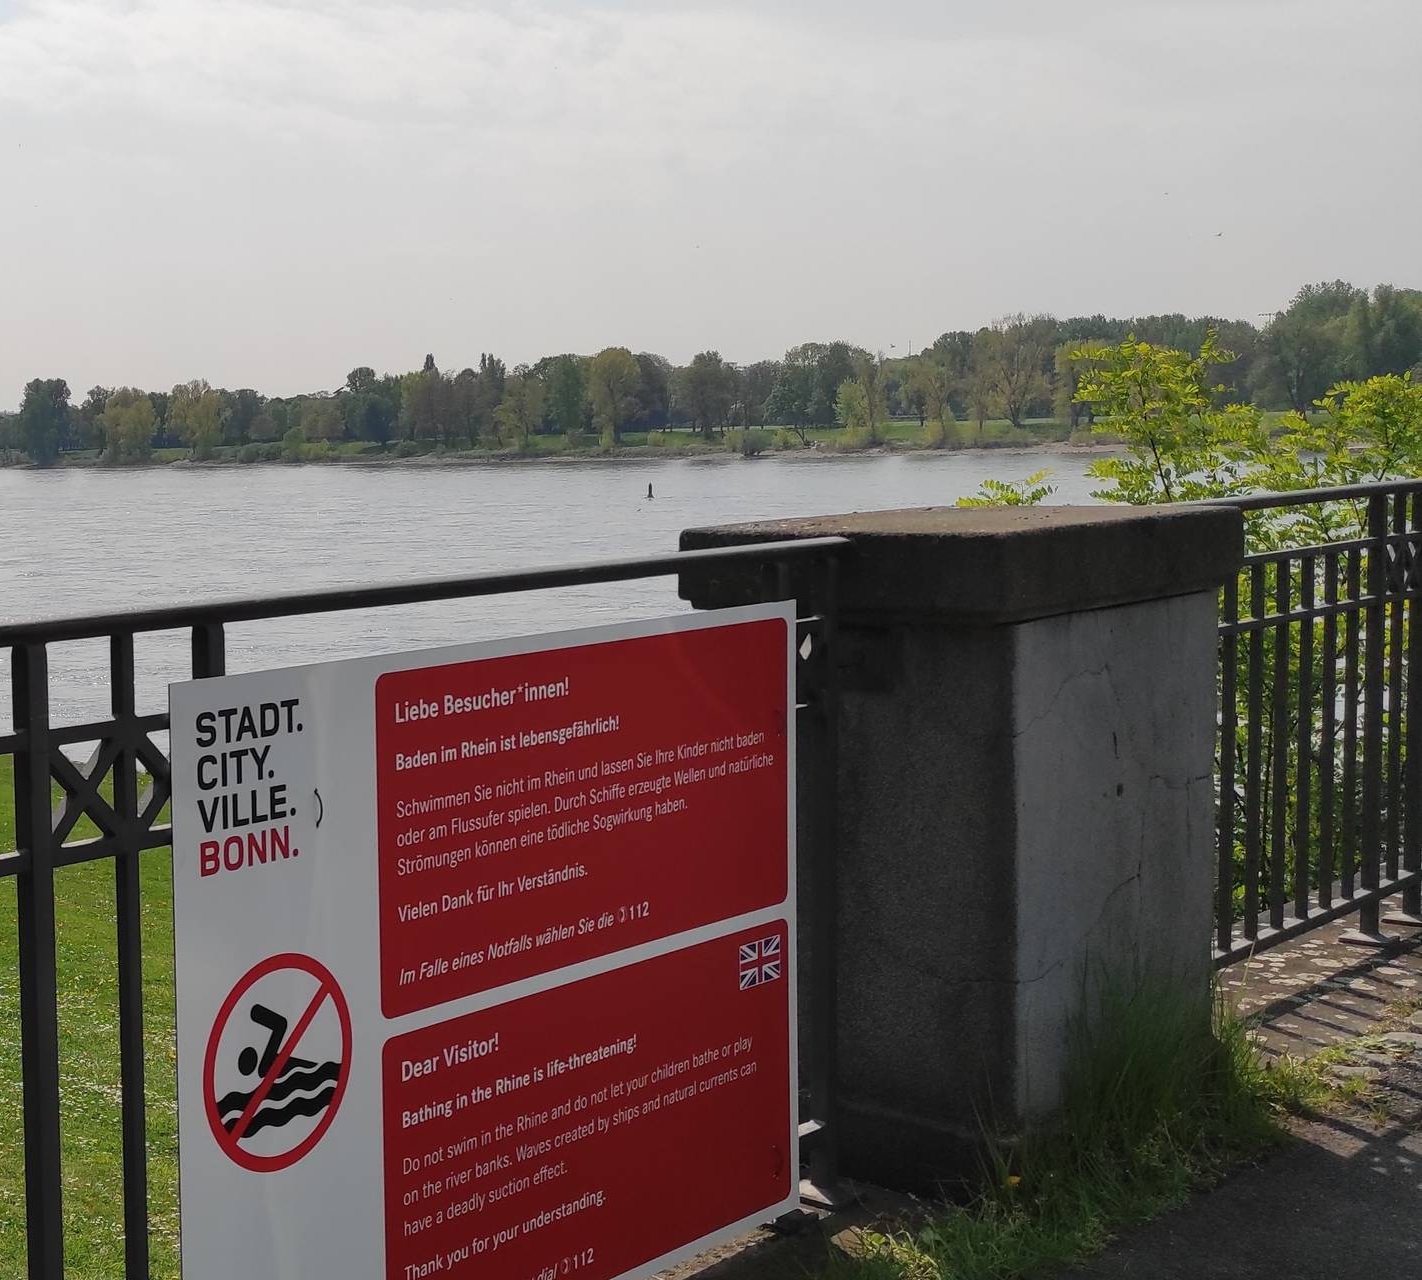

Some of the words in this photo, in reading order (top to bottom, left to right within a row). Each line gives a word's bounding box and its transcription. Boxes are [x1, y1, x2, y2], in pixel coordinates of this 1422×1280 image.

[195, 698, 303, 748] STADT.
[395, 698, 439, 724] Liebe
[395, 749, 437, 771] Baden
[440, 745, 458, 763] im
[461, 737, 497, 759] Rhein
[500, 734, 517, 752] ist
[519, 714, 620, 748] lebensgefährlich!
[197, 745, 275, 791] CITY.
[396, 791, 471, 818] Schwimmen
[474, 784, 493, 802] Sie
[495, 777, 525, 798] nicht
[527, 774, 542, 792] im
[544, 767, 575, 788] Rhein
[578, 761, 598, 781] und
[601, 758, 634, 776] lassen
[636, 752, 653, 769] Sie
[655, 749, 675, 765] Ihre
[677, 741, 709, 761] Kinder
[710, 735, 734, 753] nicht
[736, 731, 765, 748] baden
[396, 827, 426, 847] oder
[428, 824, 448, 841] am
[451, 809, 505, 835] Flussufer
[507, 801, 551, 827] spielen.
[554, 791, 587, 813] Durch
[589, 782, 626, 805] Schiffe
[628, 775, 672, 797] erzeugte
[673, 767, 706, 787] Wellen
[708, 760, 726, 779] und
[728, 753, 774, 774] natürliche
[197, 784, 296, 833] VILLE.
[397, 847, 472, 876] Strömungen
[474, 837, 517, 858] können
[519, 829, 544, 848] eine
[546, 818, 590, 841] tödliche
[592, 805, 653, 832] Sogwirkung
[654, 798, 688, 816] haben.
[200, 826, 299, 877] BONN.
[397, 900, 438, 923] Vielen
[441, 888, 474, 912] Dank
[476, 884, 495, 903] für
[497, 880, 515, 898] Ihr
[517, 862, 589, 893] Verständnis.
[399, 968, 416, 986] Im
[419, 957, 449, 981] Falle
[451, 950, 485, 971] eines
[487, 934, 533, 961] Notfalls
[535, 923, 575, 948] wählen
[577, 917, 595, 935] Sie
[597, 911, 615, 930] die
[629, 900, 650, 921] 112
[401, 1055, 440, 1083] Dear
[442, 1031, 499, 1068] Visitor!
[402, 1099, 453, 1129] Bathing
[456, 1093, 468, 1110] in
[470, 1086, 493, 1104] the
[495, 1073, 531, 1096] Rhine
[533, 1066, 544, 1083] is
[546, 1033, 637, 1078] life-threatening!
[403, 1157, 421, 1175] Do
[424, 1146, 444, 1168] not
[447, 1136, 478, 1159] swim
[481, 1130, 492, 1147] in
[494, 1123, 514, 1141] the
[516, 1111, 548, 1133] Rhine
[551, 1098, 571, 1120] and
[573, 1095, 588, 1112] do
[590, 1087, 608, 1106] not
[610, 1080, 624, 1098] let
[626, 1074, 649, 1097] your
[650, 1059, 690, 1084] children
[692, 1048, 720, 1068] bathe
[721, 1044, 732, 1058] or
[733, 1036, 753, 1057] play
[403, 1189, 419, 1206] on
[422, 1180, 442, 1199] the
[445, 1168, 473, 1190] river
[475, 1154, 513, 1179] banks.
[515, 1139, 552, 1162] Waves
[554, 1118, 595, 1148] created
[597, 1116, 610, 1134] by
[612, 1105, 640, 1126] ships
[641, 1093, 661, 1115] and
[663, 1080, 697, 1107] natural
[699, 1068, 738, 1093] currents
[740, 1061, 757, 1077] can
[404, 1215, 433, 1237] have
[436, 1210, 443, 1224] a
[446, 1192, 486, 1220] deadly
[488, 1176, 530, 1203] suction
[532, 1160, 568, 1185] effect.
[404, 1253, 444, 1280] Thank
[446, 1245, 469, 1271] you
[471, 1236, 490, 1255] for
[492, 1224, 520, 1251] your
[522, 1190, 607, 1234] understanding.
[537, 1263, 558, 1280] dial
[573, 1247, 595, 1269] 112
